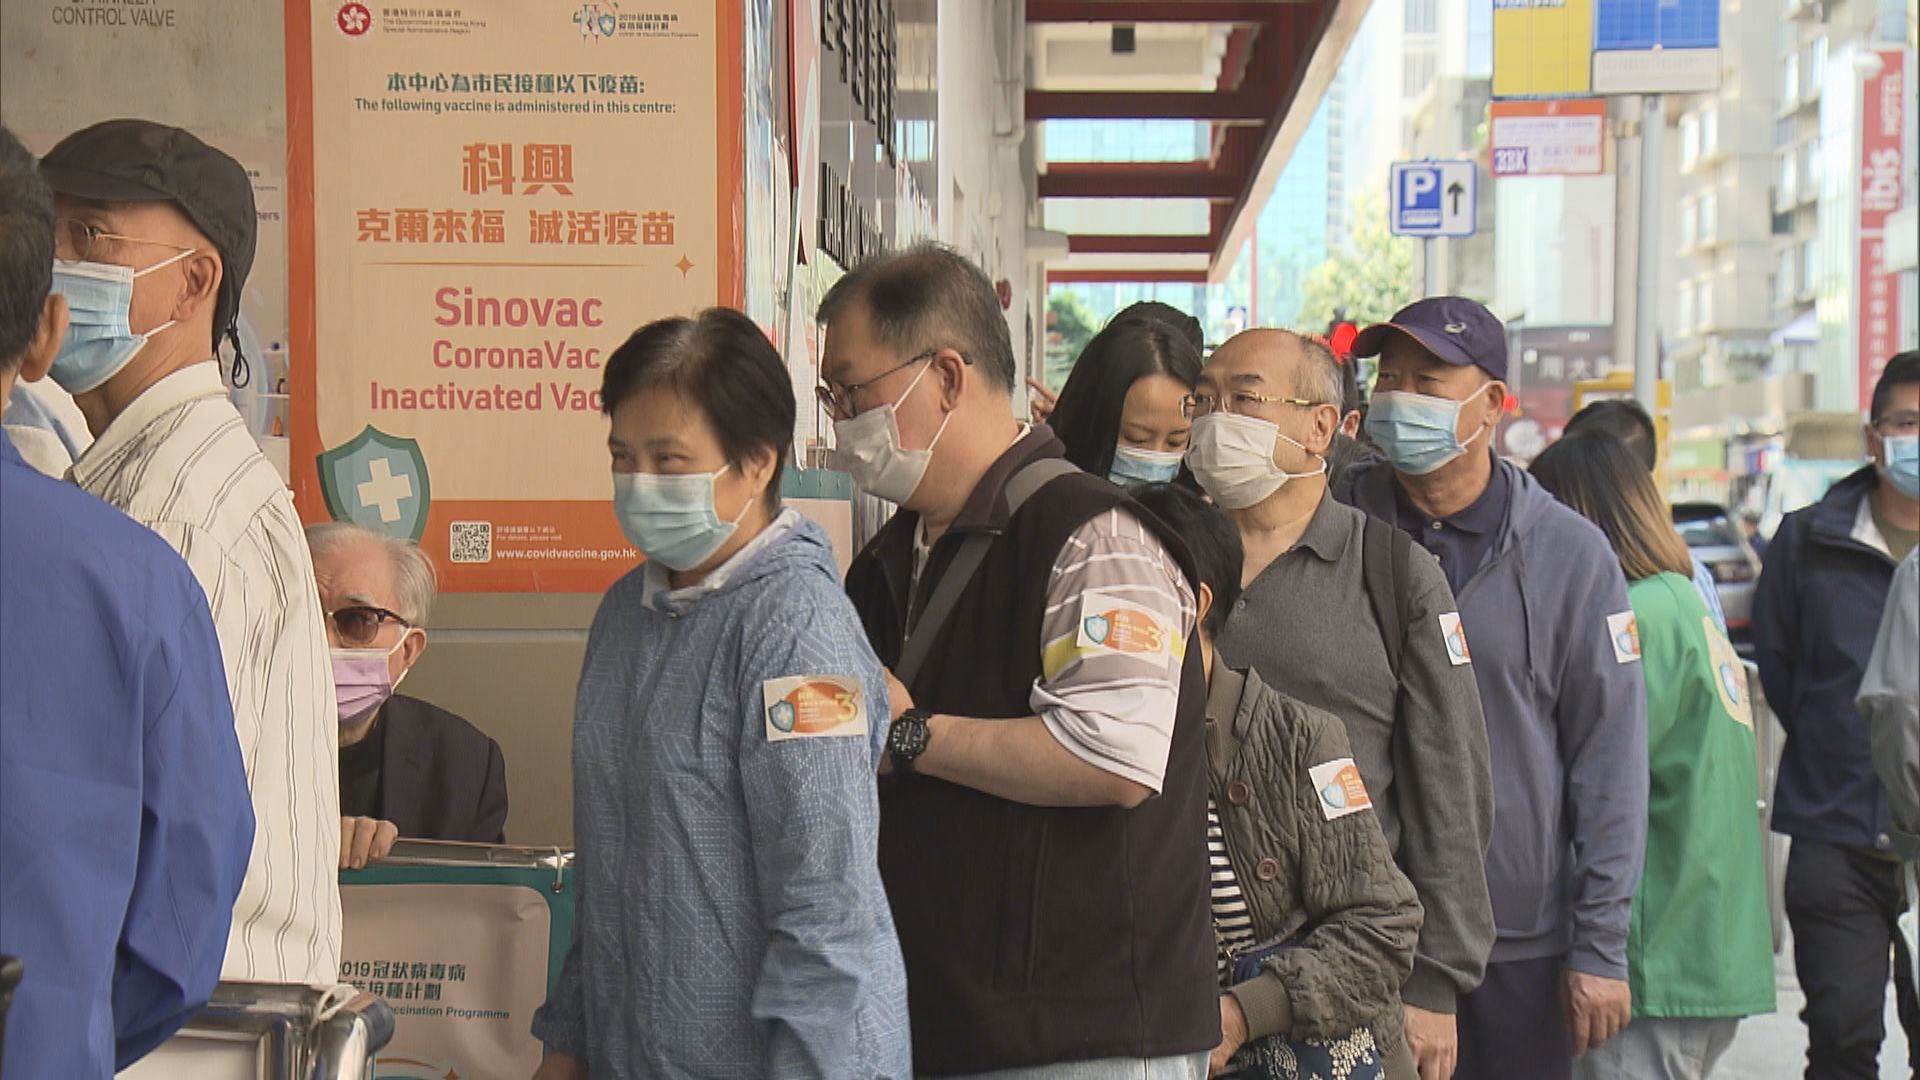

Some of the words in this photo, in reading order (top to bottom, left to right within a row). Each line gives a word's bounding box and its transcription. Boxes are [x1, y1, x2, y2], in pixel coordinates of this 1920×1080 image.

[52, 6, 126, 26] CONTROL
[130, 8, 175, 27] VALVE
[387, 72, 645, 93] 本中心為市民接種以下疫苗:
[355, 98, 379, 111] The
[382, 98, 441, 114] following
[445, 101, 491, 112] vaccine
[494, 100, 505, 112] is
[507, 100, 590, 113] administered
[593, 101, 604, 113] in
[607, 101, 630, 113] this
[633, 102, 676, 113] centre:
[462, 142, 574, 195] 科興
[1863, 148, 1900, 210] ibis
[1405, 170, 1437, 207] P
[356, 208, 505, 243] 克爾來福
[529, 209, 675, 245] 滅活疫苗
[434, 286, 603, 327] Sinovac
[432, 339, 600, 369] CoronaVac
[370, 381, 542, 410] Inactivated
[496, 548, 637, 561] www.covidvaccine.gov.hk
[835, 693, 858, 721] 3
[339, 960, 466, 981] 019冠狀病毒病
[446, 1006, 510, 1020] Programme
